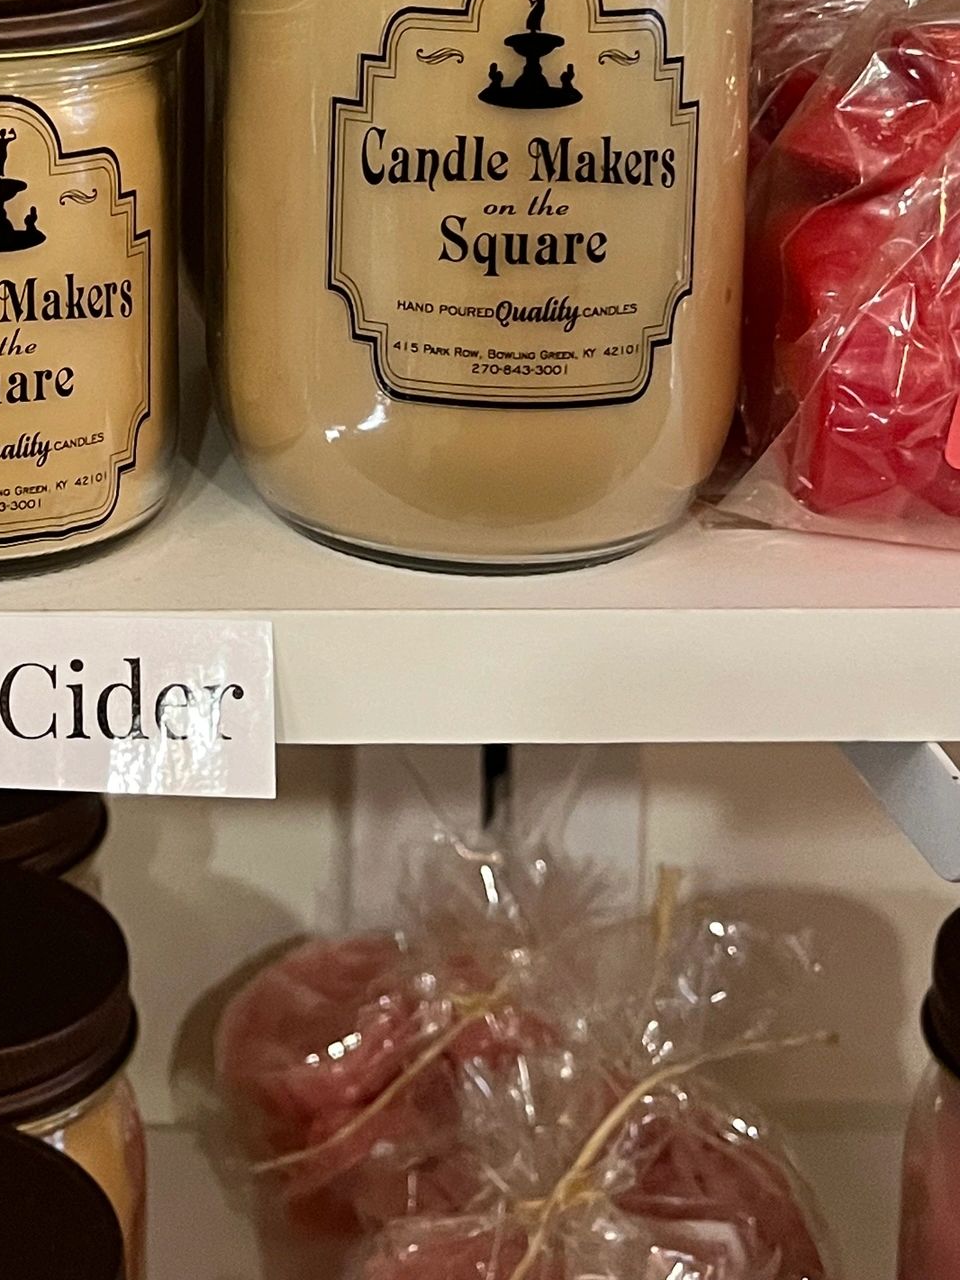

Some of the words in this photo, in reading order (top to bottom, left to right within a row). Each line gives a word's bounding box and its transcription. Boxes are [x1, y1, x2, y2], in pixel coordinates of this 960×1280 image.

[361, 126, 509, 192] Candle
[527, 136, 676, 189] Makers
[483, 202, 517, 217] on
[528, 188, 570, 217] the
[438, 214, 608, 277] Square
[396, 300, 434, 314] HAND
[439, 304, 495, 318] POURED
[495, 295, 582, 333] Quality
[582, 303, 638, 318] CANDLES
[393, 341, 419, 353] 415
[582, 348, 597, 359] KY
[603, 344, 640, 357] 42101
[472, 363, 568, 376] 270-843-3001
[53, 432, 105, 451] CANDLES
[55, 480, 69, 491] KY
[74, 471, 108, 487] 42101
